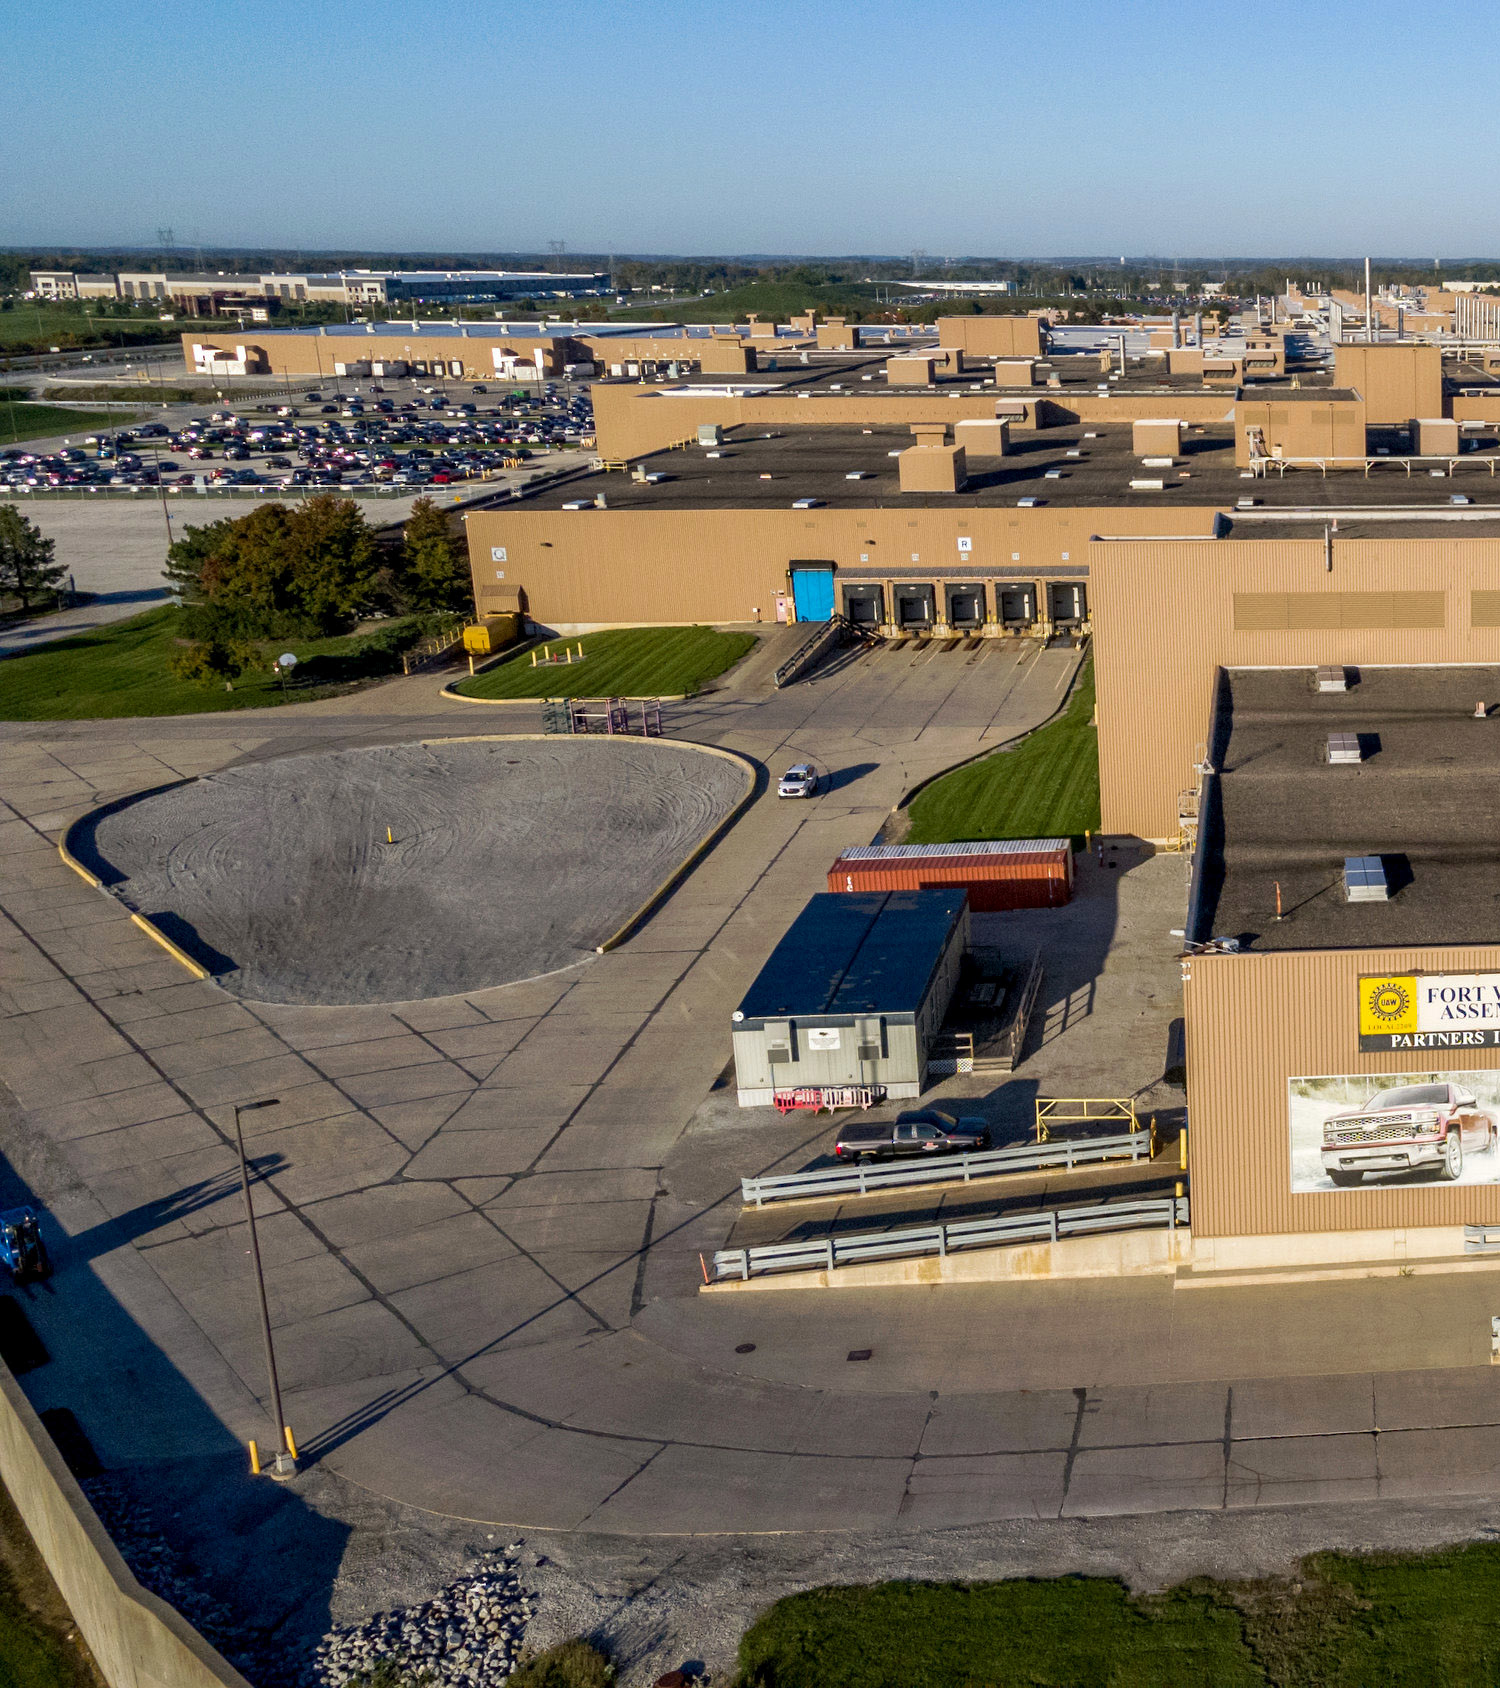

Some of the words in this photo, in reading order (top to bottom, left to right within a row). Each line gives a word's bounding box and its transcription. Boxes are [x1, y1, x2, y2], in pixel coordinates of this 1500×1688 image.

[494, 549, 505, 560] Q
[1381, 998, 1398, 1006] UAW
[1427, 986, 1486, 1004] FORT
[1391, 1031, 1485, 1048] PARTNERS
